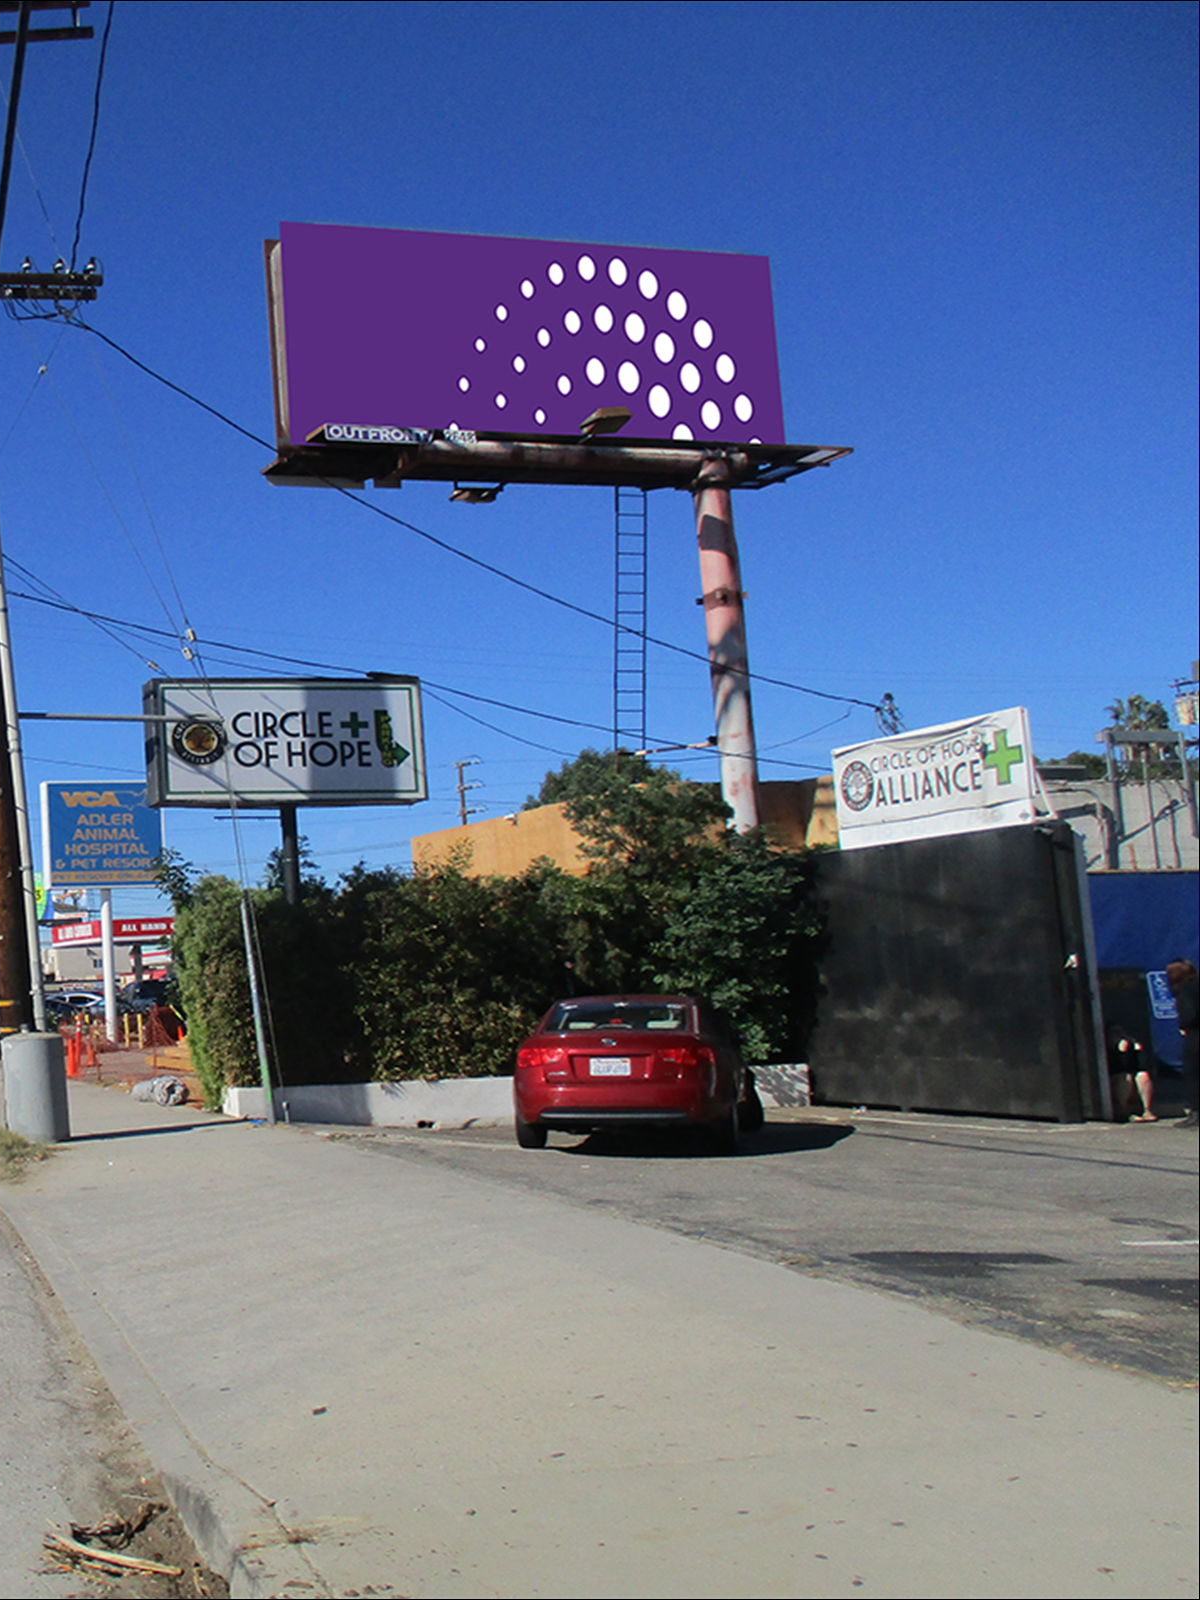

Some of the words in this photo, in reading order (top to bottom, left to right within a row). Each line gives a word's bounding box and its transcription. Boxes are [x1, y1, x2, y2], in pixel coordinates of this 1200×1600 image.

[231, 711, 333, 738] CIRCLE
[233, 741, 279, 768] OF
[287, 741, 372, 768] HOPE
[870, 750, 912, 774] CIRCLE
[916, 745, 936, 765] OF
[875, 759, 983, 808] ALLIANCE
[60, 791, 120, 808] VCA
[77, 813, 134, 826] ADLER
[72, 828, 140, 841] ANIMAL
[65, 843, 150, 856] HOSPITAL
[55, 859, 66, 870] &
[71, 858, 99, 869] PET
[103, 857, 154, 869] RESOR
[121, 923, 138, 932] ALL
